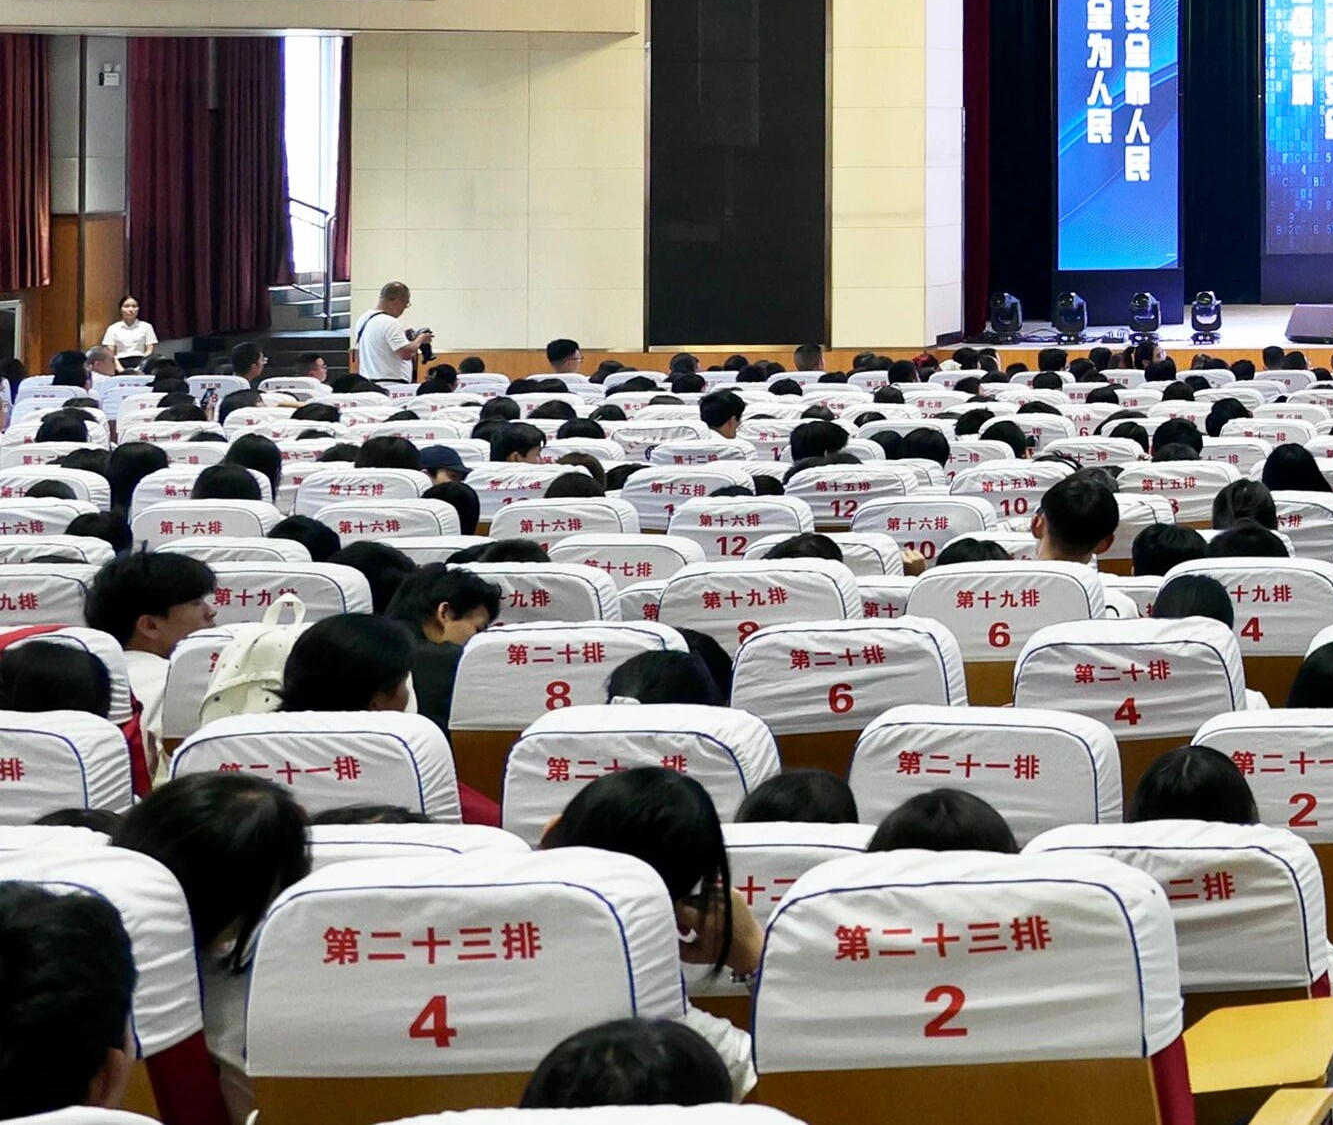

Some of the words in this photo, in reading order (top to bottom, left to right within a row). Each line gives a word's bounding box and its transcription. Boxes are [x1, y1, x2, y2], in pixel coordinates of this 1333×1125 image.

[758, 431, 790, 442] 第十一
[22, 455, 62, 465] 第十二
[949, 452, 981, 463] 十二排
[1, 486, 25, 498] 第十
[164, 485, 188, 497] 第十
[329, 484, 384, 496] 第十五排
[651, 482, 706, 497] 第十五排
[816, 481, 871, 493] 第十五排
[981, 477, 1037, 494] 第十五排
[1141, 476, 1197, 492] 第十五排
[832, 498, 858, 519] 12
[1001, 497, 1029, 517] 10
[0, 521, 45, 534] 十六排
[160, 521, 222, 534] 第十六排
[339, 520, 400, 534] 第十六排
[521, 518, 582, 533] 第十六排
[699, 513, 761, 527] 第十六排
[887, 517, 948, 531] 第十六排
[1277, 515, 1302, 528] 六排
[718, 535, 748, 558] 12
[0, 593, 38, 612] 九排
[497, 588, 551, 609] 九排
[703, 588, 788, 610] 第十九排
[956, 589, 1039, 609] 第十九排
[1232, 585, 1293, 602] 十九排
[864, 601, 896, 618] 第十
[988, 622, 1012, 649] 6
[1241, 617, 1263, 642] 4
[507, 642, 604, 666] 第二十排
[790, 645, 885, 669] 第二十排
[1075, 659, 1170, 684] 第二十排
[545, 680, 572, 710] 8
[828, 683, 854, 714] 6
[1114, 697, 1141, 725] 4
[547, 754, 687, 782] 第二十排
[898, 750, 1039, 780] 第二十一排
[1288, 792, 1318, 828] 2
[322, 922, 541, 966] 第二十三排
[835, 915, 1052, 961] 第二十三排
[409, 995, 457, 1048] 4
[924, 985, 968, 1038] 2
